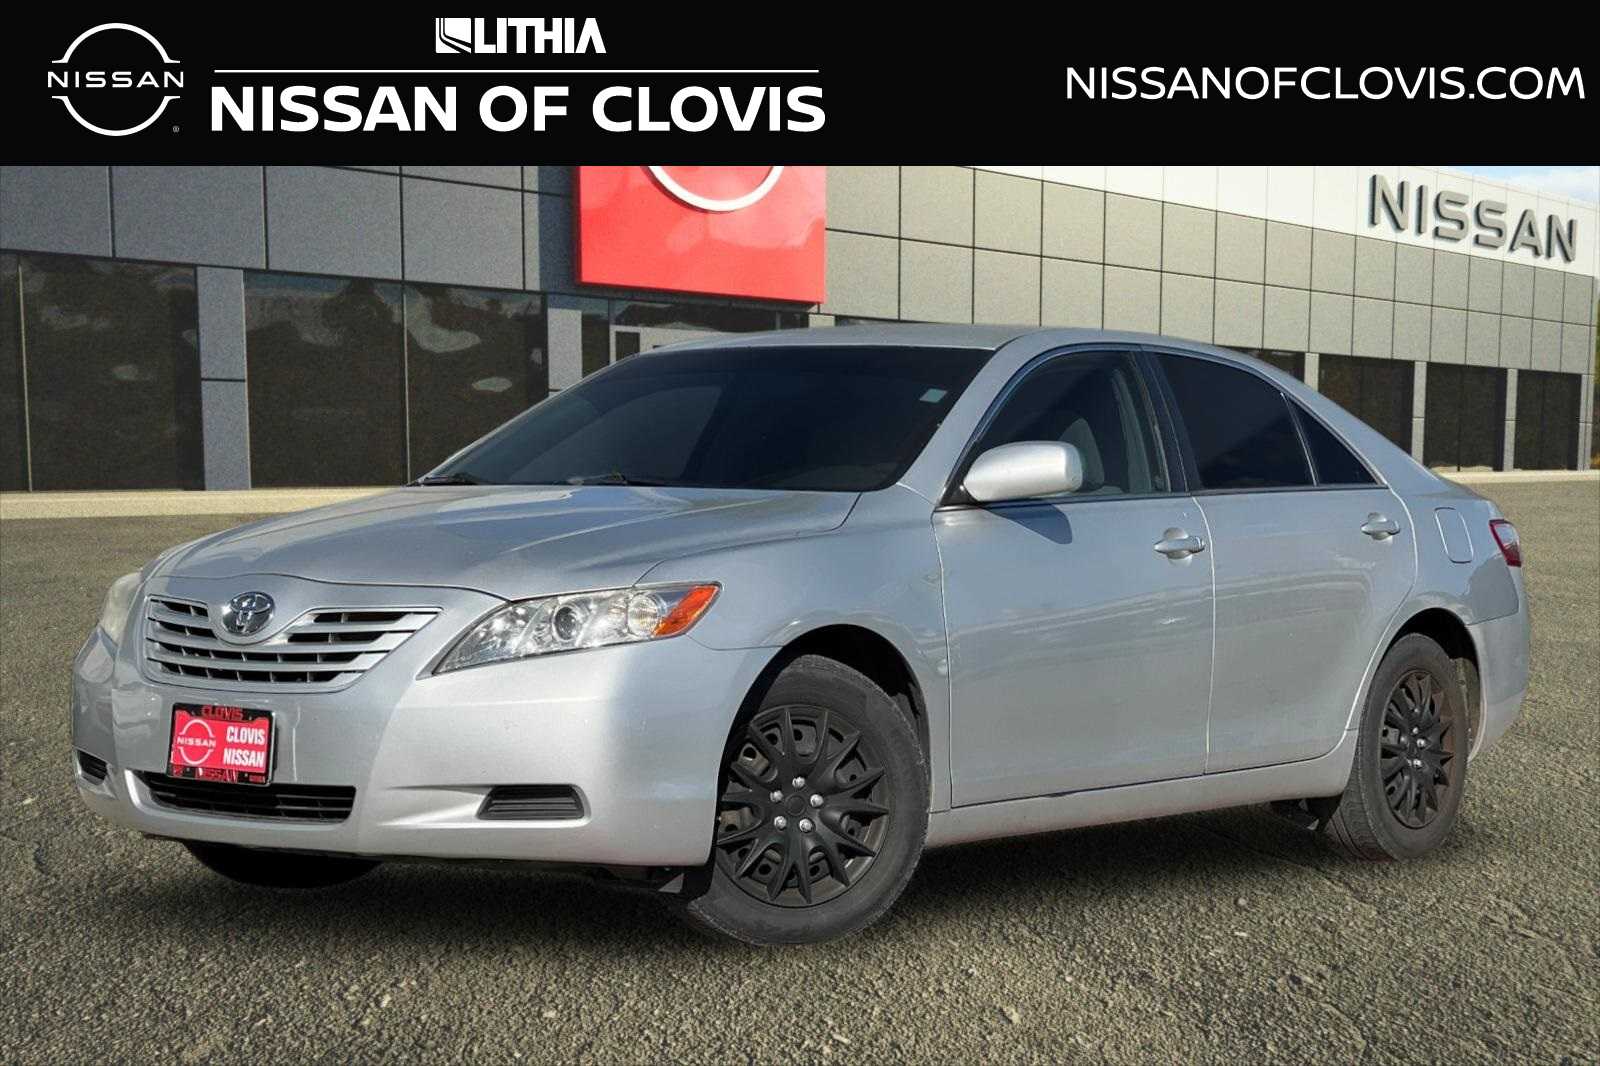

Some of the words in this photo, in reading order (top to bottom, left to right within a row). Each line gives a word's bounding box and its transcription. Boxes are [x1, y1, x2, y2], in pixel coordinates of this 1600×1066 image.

[1369, 174, 1578, 263] NISSAN
[177, 736, 216, 748] NISSAN
[226, 725, 265, 746] CLOVIS
[223, 748, 265, 768] NISSAN
